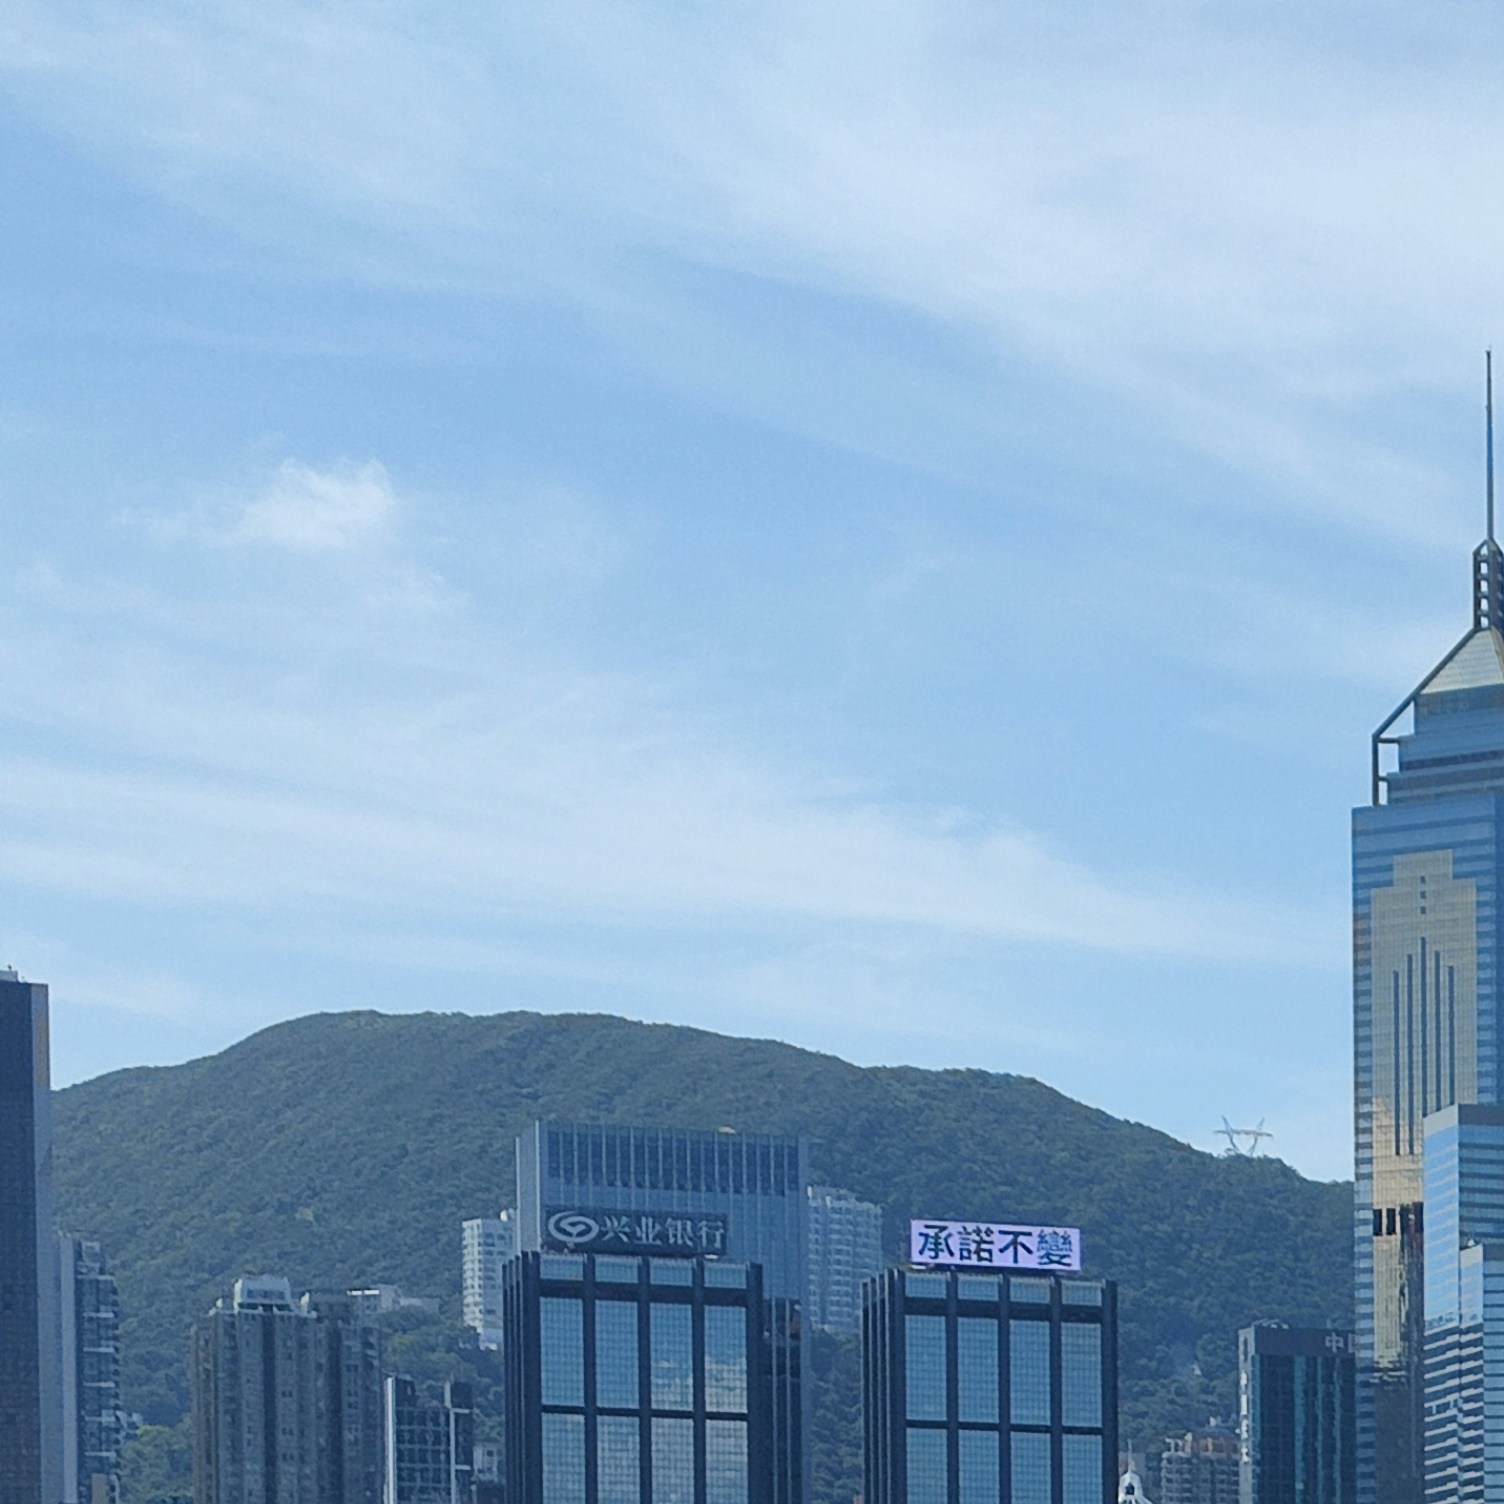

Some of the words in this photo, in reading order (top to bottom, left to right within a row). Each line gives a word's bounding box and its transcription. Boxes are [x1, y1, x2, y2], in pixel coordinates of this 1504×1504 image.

[601, 1215, 724, 1248] 兴业银行
[918, 1225, 1073, 1267] 承諾不變
